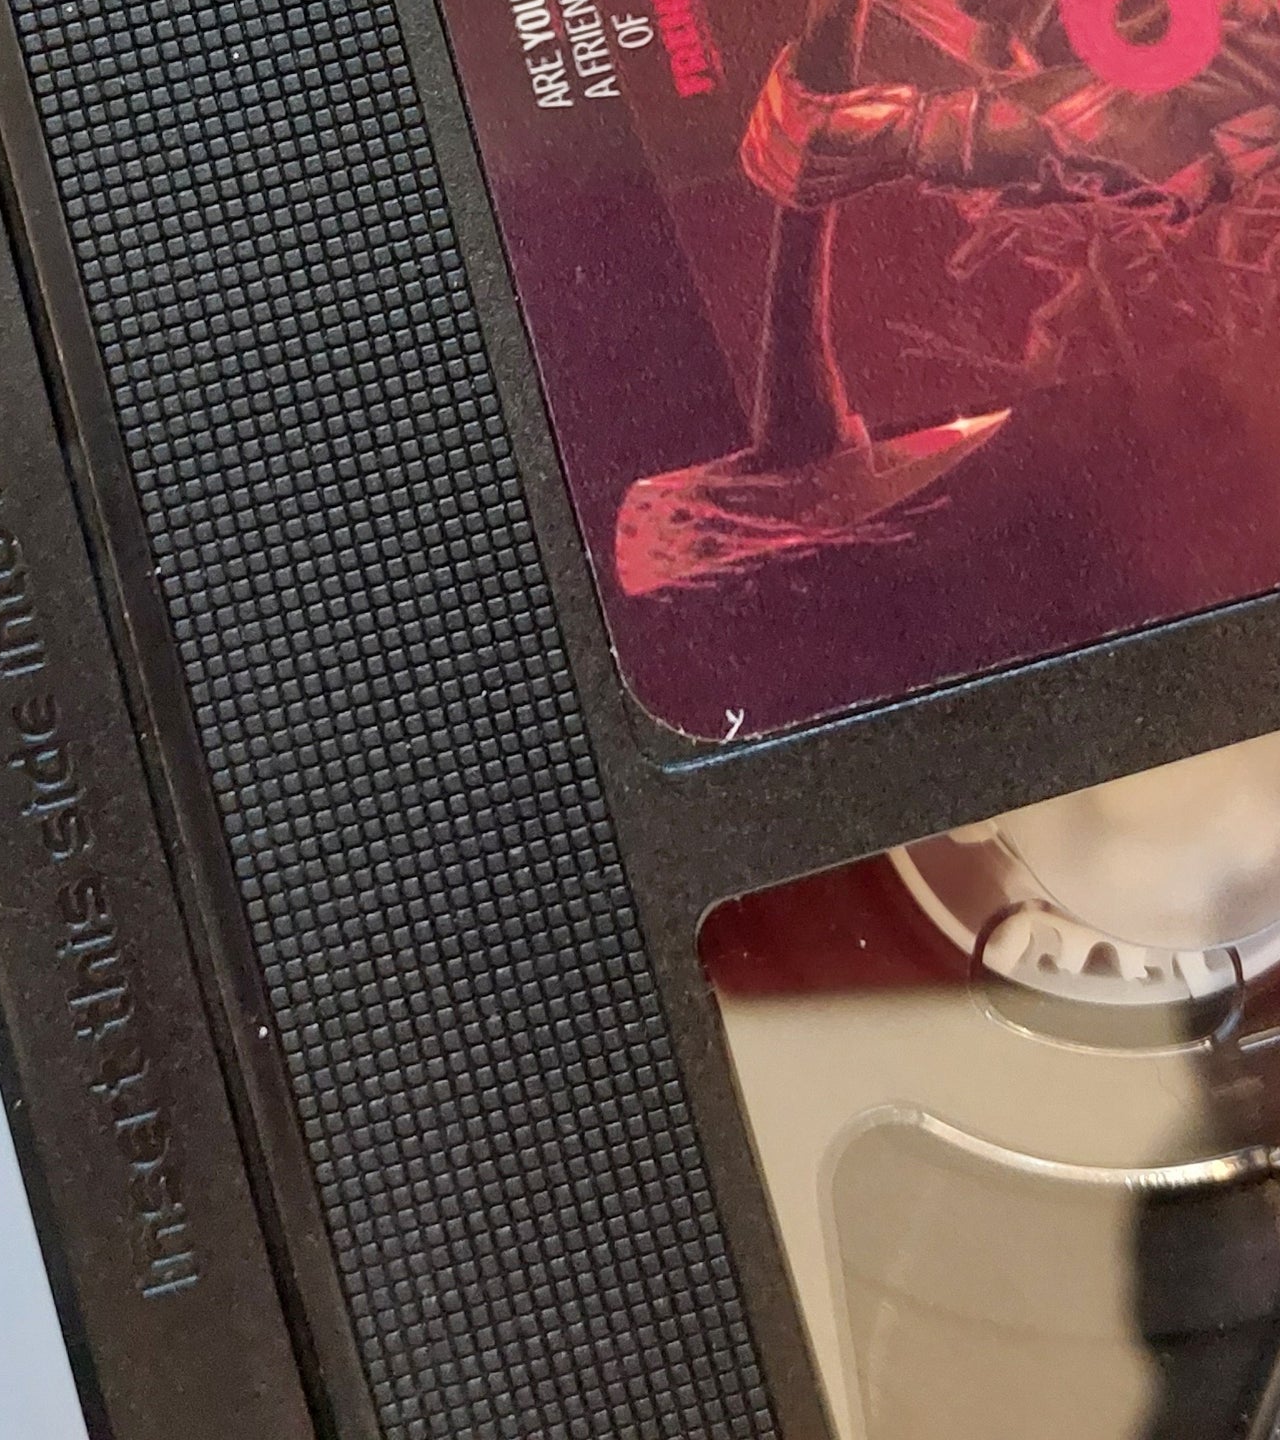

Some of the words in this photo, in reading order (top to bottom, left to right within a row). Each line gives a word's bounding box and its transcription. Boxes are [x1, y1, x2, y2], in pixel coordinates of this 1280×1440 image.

[525, 49, 574, 109] ARE
[611, 12, 654, 49] OF
[584, 76, 620, 99] A
[7, 693, 92, 861] side
[58, 880, 134, 1041] this
[90, 1058, 200, 1299] Insert
